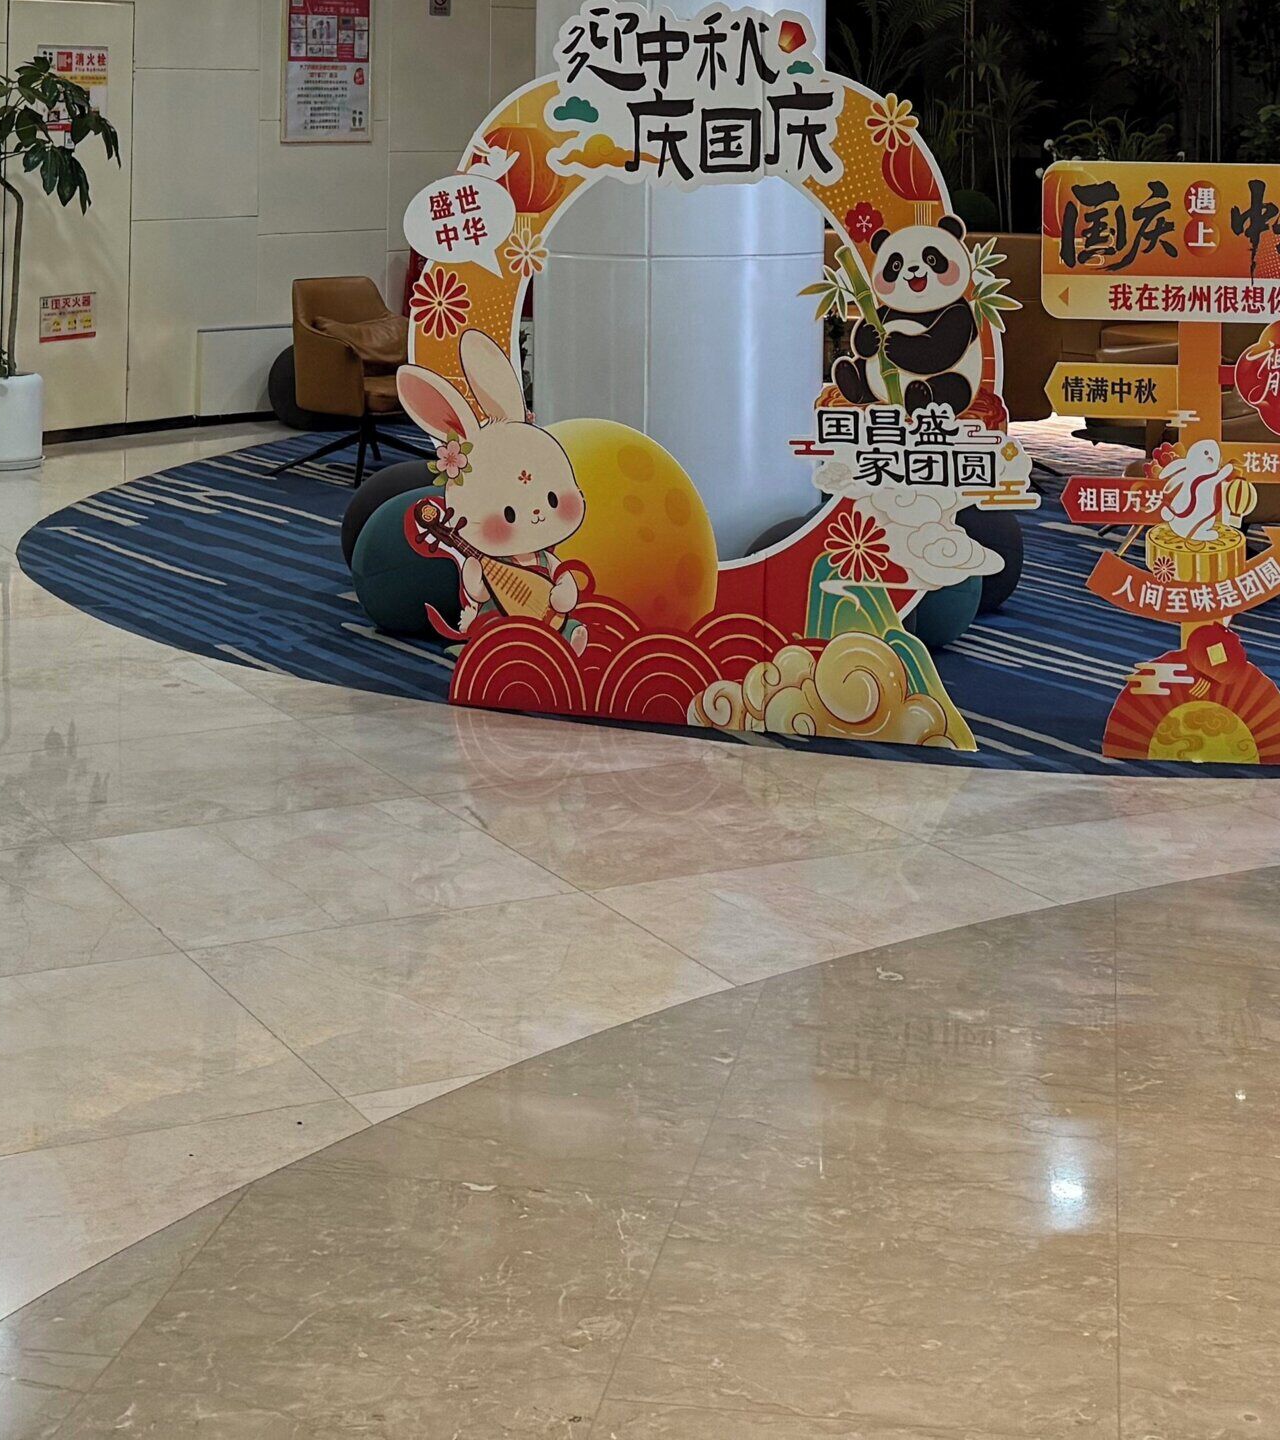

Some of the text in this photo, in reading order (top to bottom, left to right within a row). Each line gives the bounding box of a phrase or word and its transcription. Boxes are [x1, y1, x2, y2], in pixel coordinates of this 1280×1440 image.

[562, 7, 780, 91] 迎中秋
[624, 82, 834, 181] 庆国庆
[429, 184, 482, 221] 盛世
[435, 216, 488, 252] 中华
[1060, 180, 1179, 271] 国庆
[1187, 187, 1218, 248] 遇上
[1061, 376, 1158, 404] 情满中秋
[817, 409, 959, 447] 国昌盛
[852, 447, 997, 488] 家团圆
[1076, 487, 1164, 513] 祖国万岁
